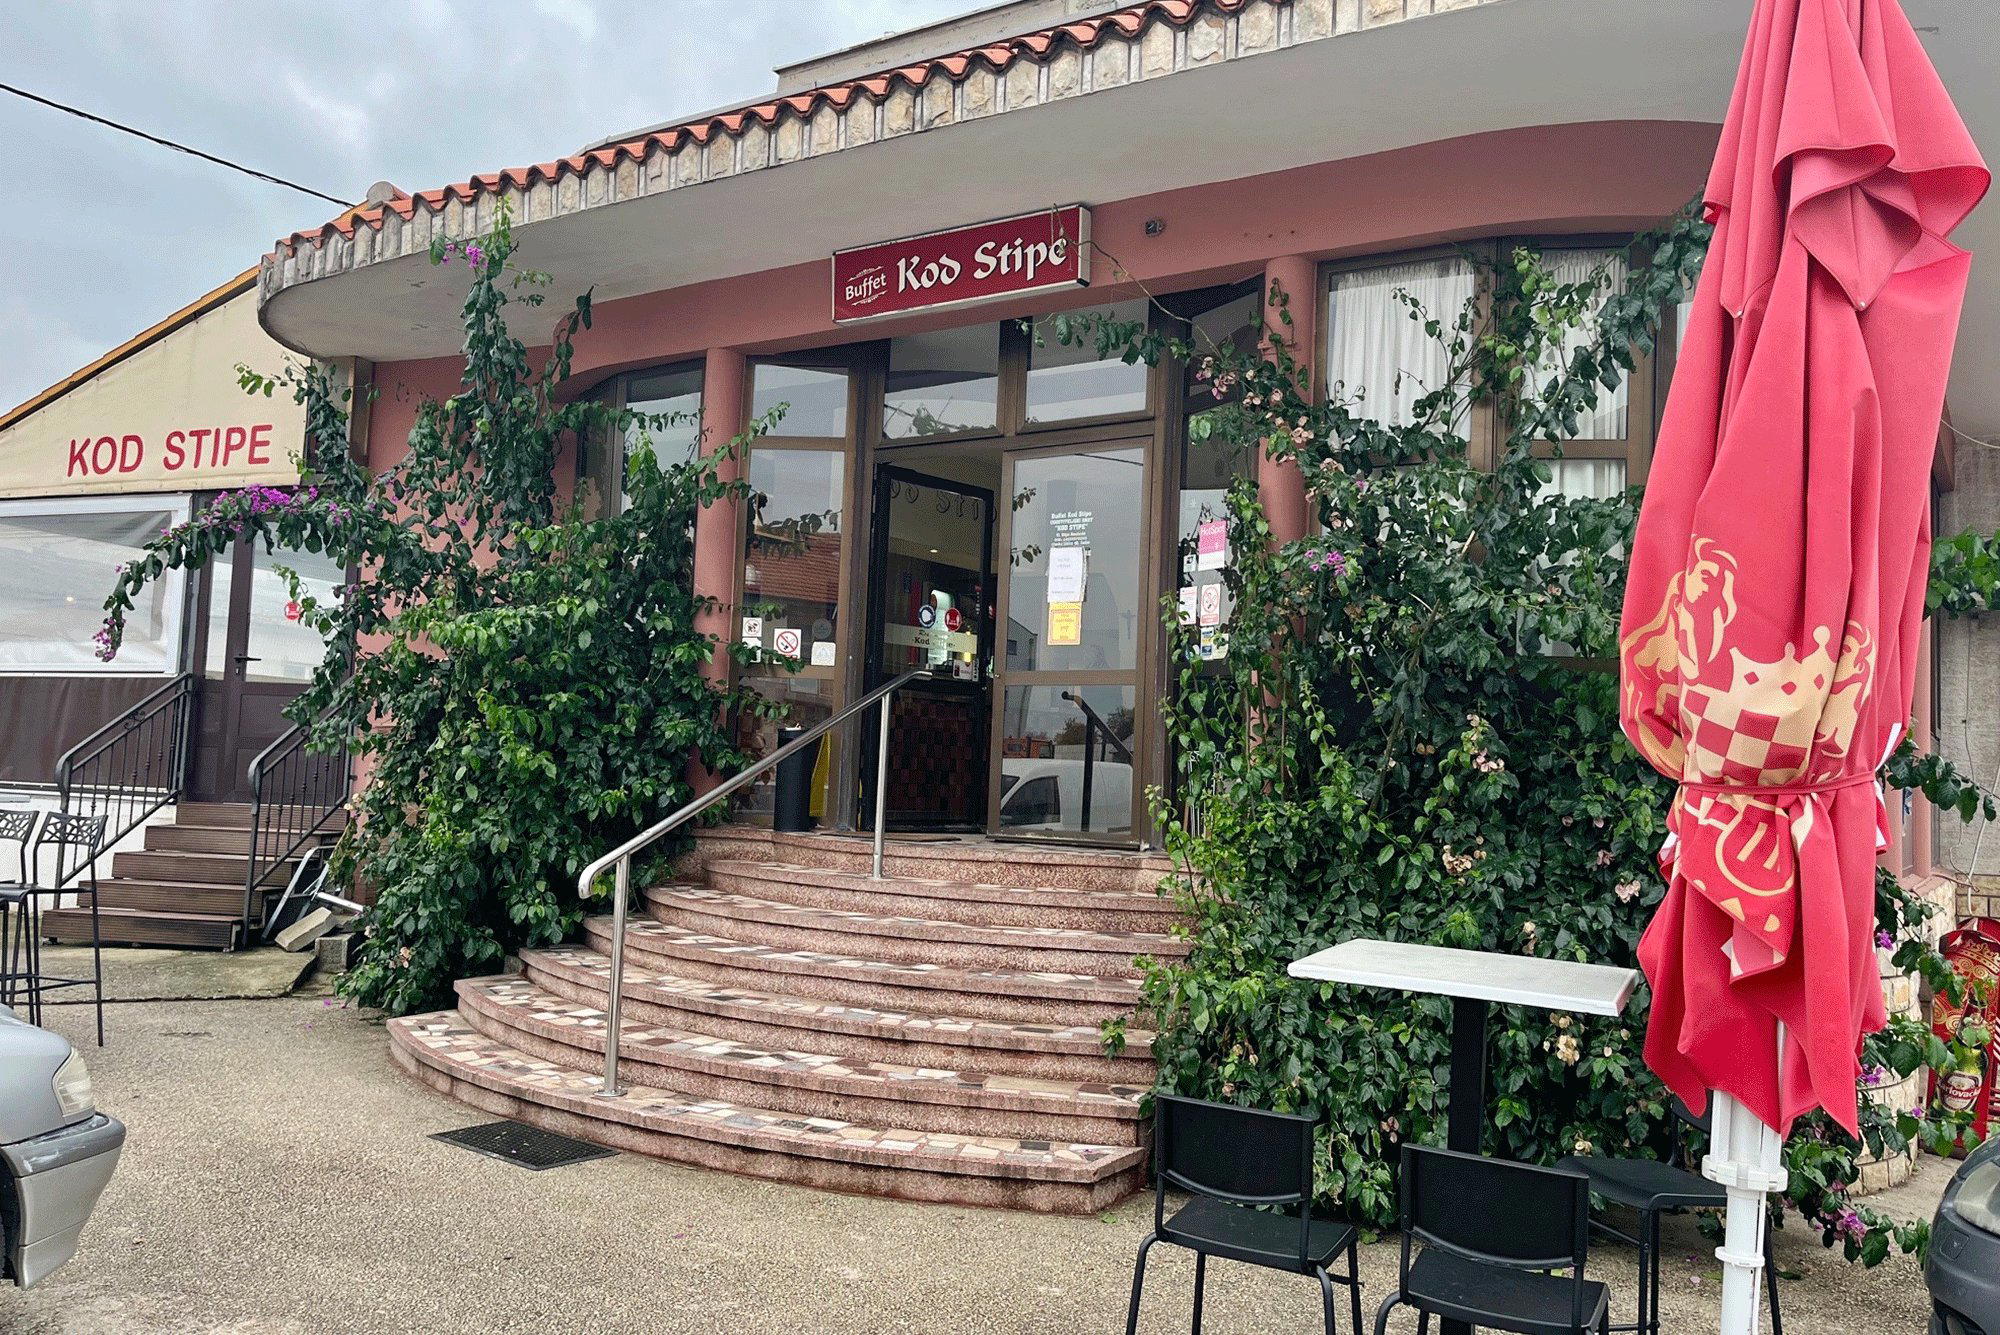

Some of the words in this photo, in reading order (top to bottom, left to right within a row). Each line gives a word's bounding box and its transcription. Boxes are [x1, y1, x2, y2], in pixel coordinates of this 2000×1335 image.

[845, 272, 887, 301] Buffet
[896, 253, 961, 293] Kod
[973, 237, 1067, 281] Stipe
[67, 435, 144, 477] KOD
[163, 424, 273, 471] STIPE
